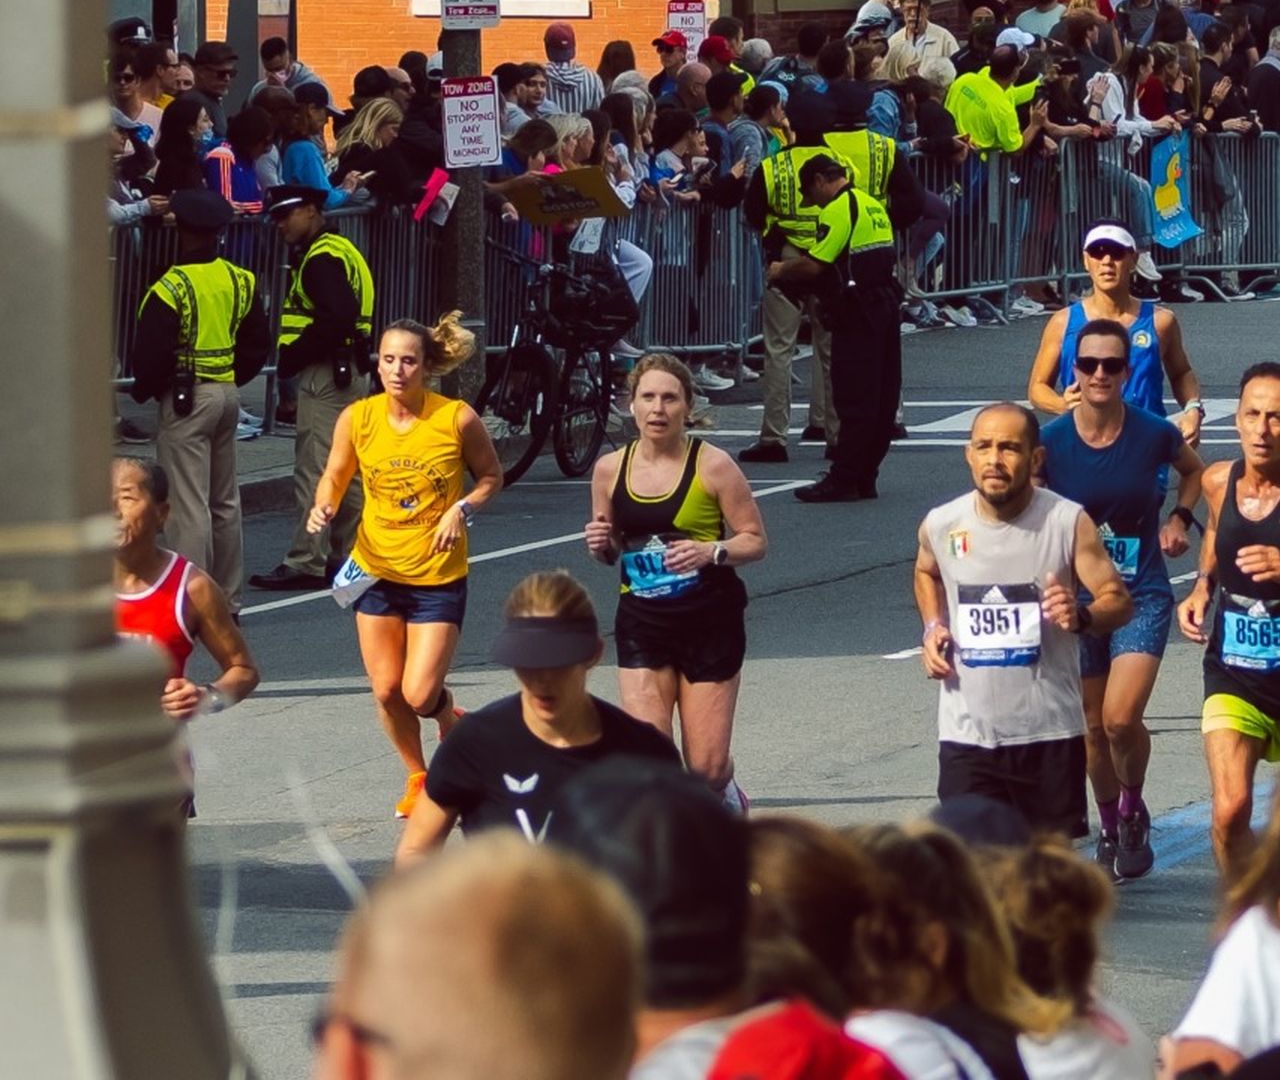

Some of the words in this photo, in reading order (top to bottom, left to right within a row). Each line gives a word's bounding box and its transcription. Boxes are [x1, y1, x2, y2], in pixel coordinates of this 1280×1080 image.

[680, 16, 696, 26] NO
[443, 83, 464, 96] TOW
[467, 81, 493, 93] ZONE
[460, 99, 480, 112] NO
[447, 111, 494, 125] STOPPING
[461, 124, 481, 134] ANY
[461, 135, 484, 145] TIME
[453, 146, 492, 158] MONDAY
[969, 607, 1021, 636] 3951
